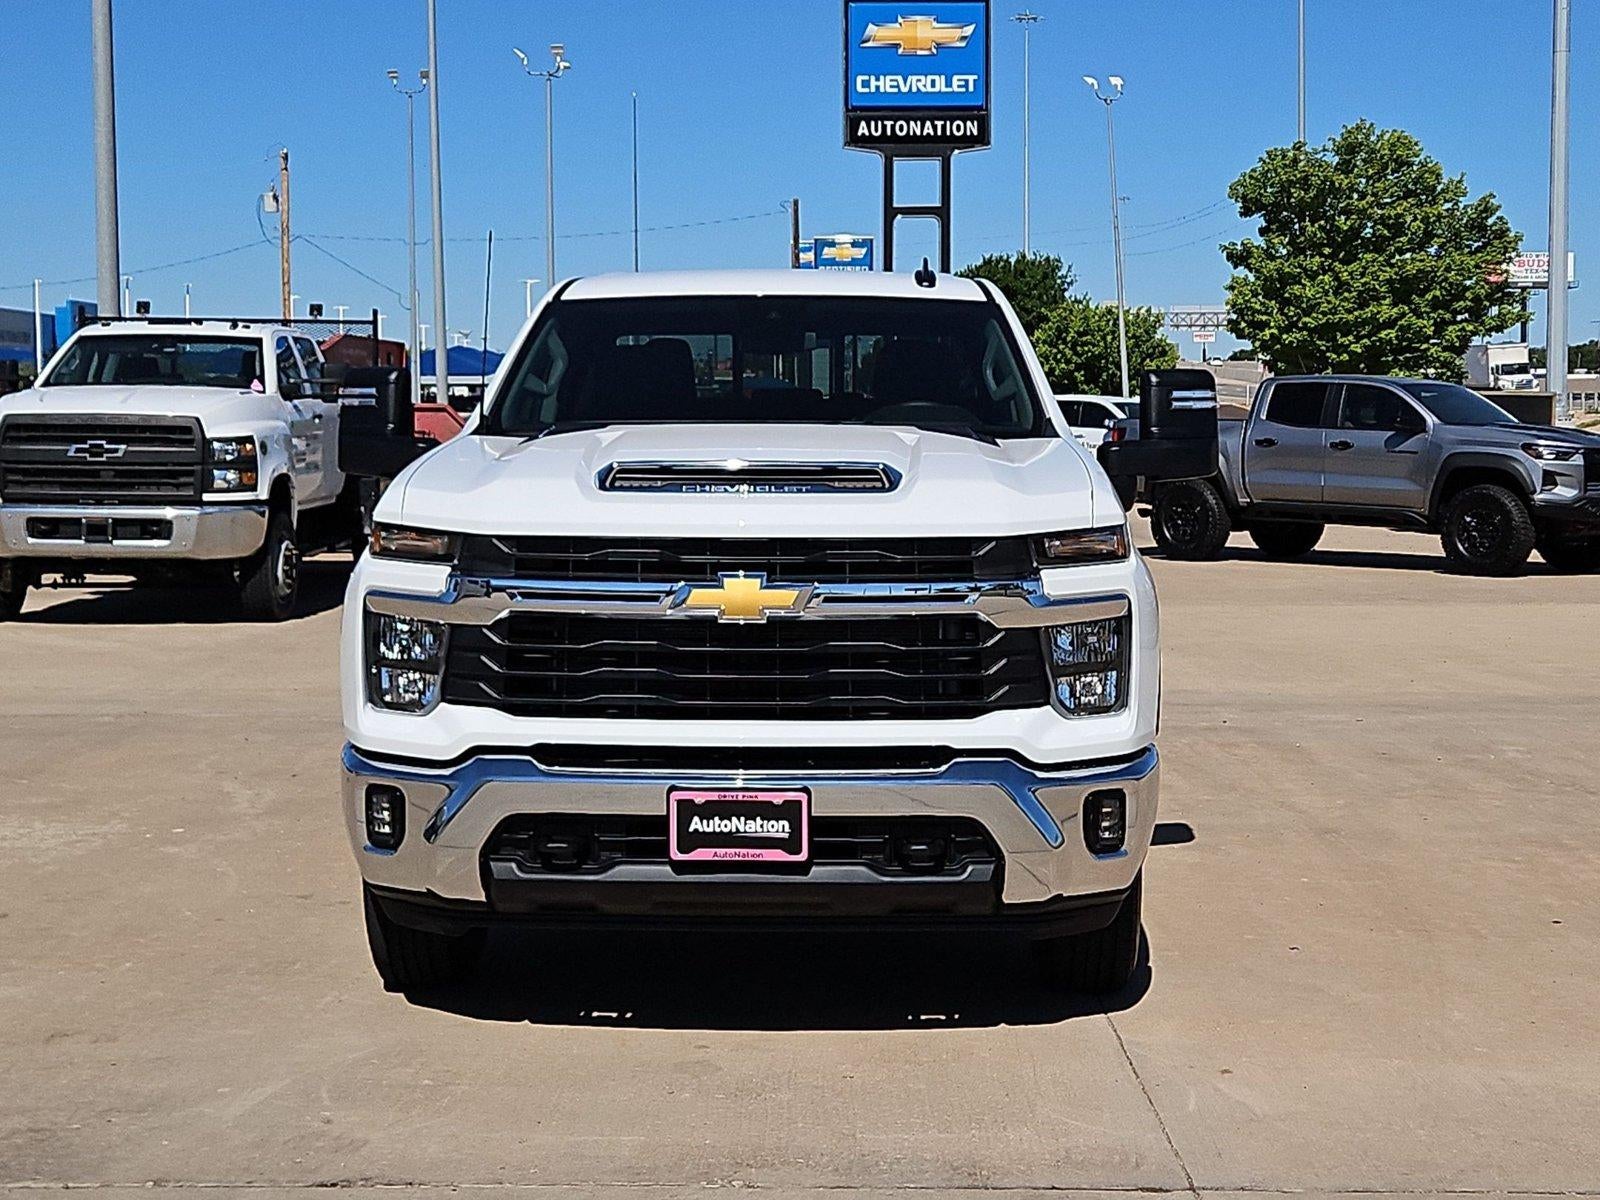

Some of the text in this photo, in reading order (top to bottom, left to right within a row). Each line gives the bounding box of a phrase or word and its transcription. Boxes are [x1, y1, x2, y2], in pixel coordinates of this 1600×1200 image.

[856, 75, 978, 92] CHEVROLET
[857, 120, 978, 137] AUTONATION
[682, 485, 811, 493] CHEVROLET
[688, 815, 791, 833] AutoNation
[712, 850, 764, 859] AutoNation
